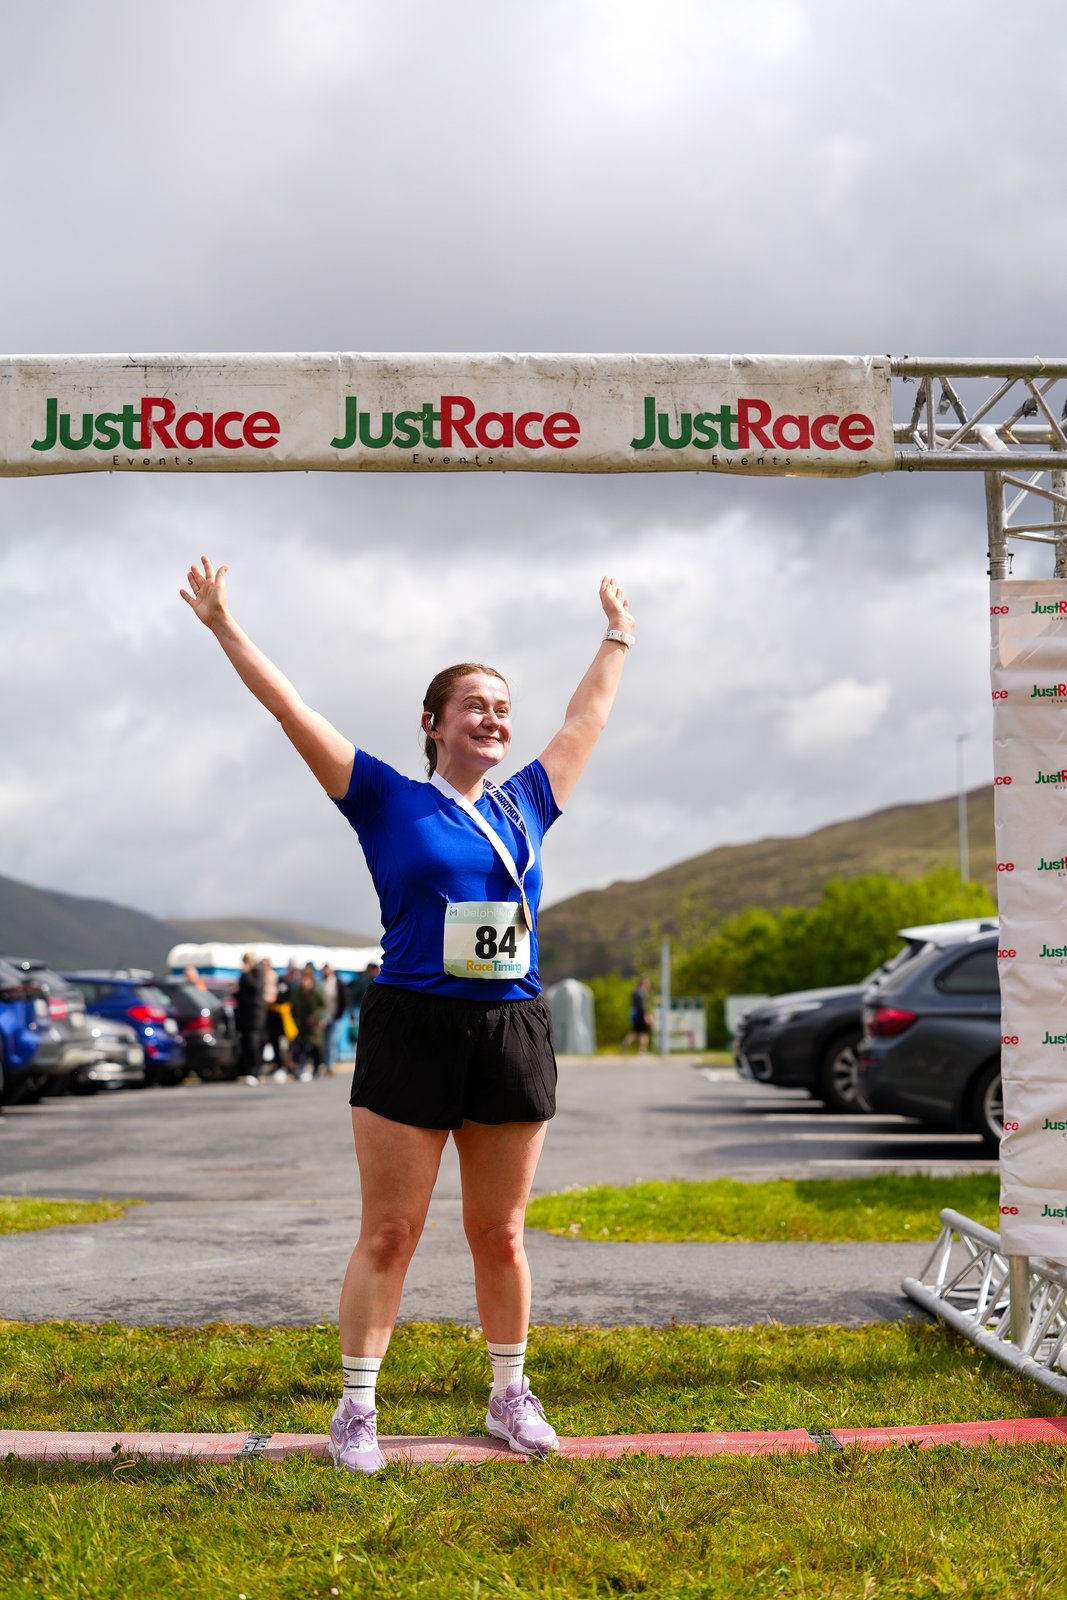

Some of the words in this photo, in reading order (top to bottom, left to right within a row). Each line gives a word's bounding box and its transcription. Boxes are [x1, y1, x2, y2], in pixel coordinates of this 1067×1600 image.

[31, 397, 281, 451] JustRace
[330, 396, 581, 449] JustRace
[630, 397, 876, 450] JustRace
[113, 456, 193, 466] Events
[412, 454, 494, 465] Events
[711, 454, 791, 466] Events
[1030, 684, 1067, 698] JustR
[1037, 856, 1067, 871] Just
[475, 925, 517, 960] 84
[466, 959, 522, 974] RaceTiming
